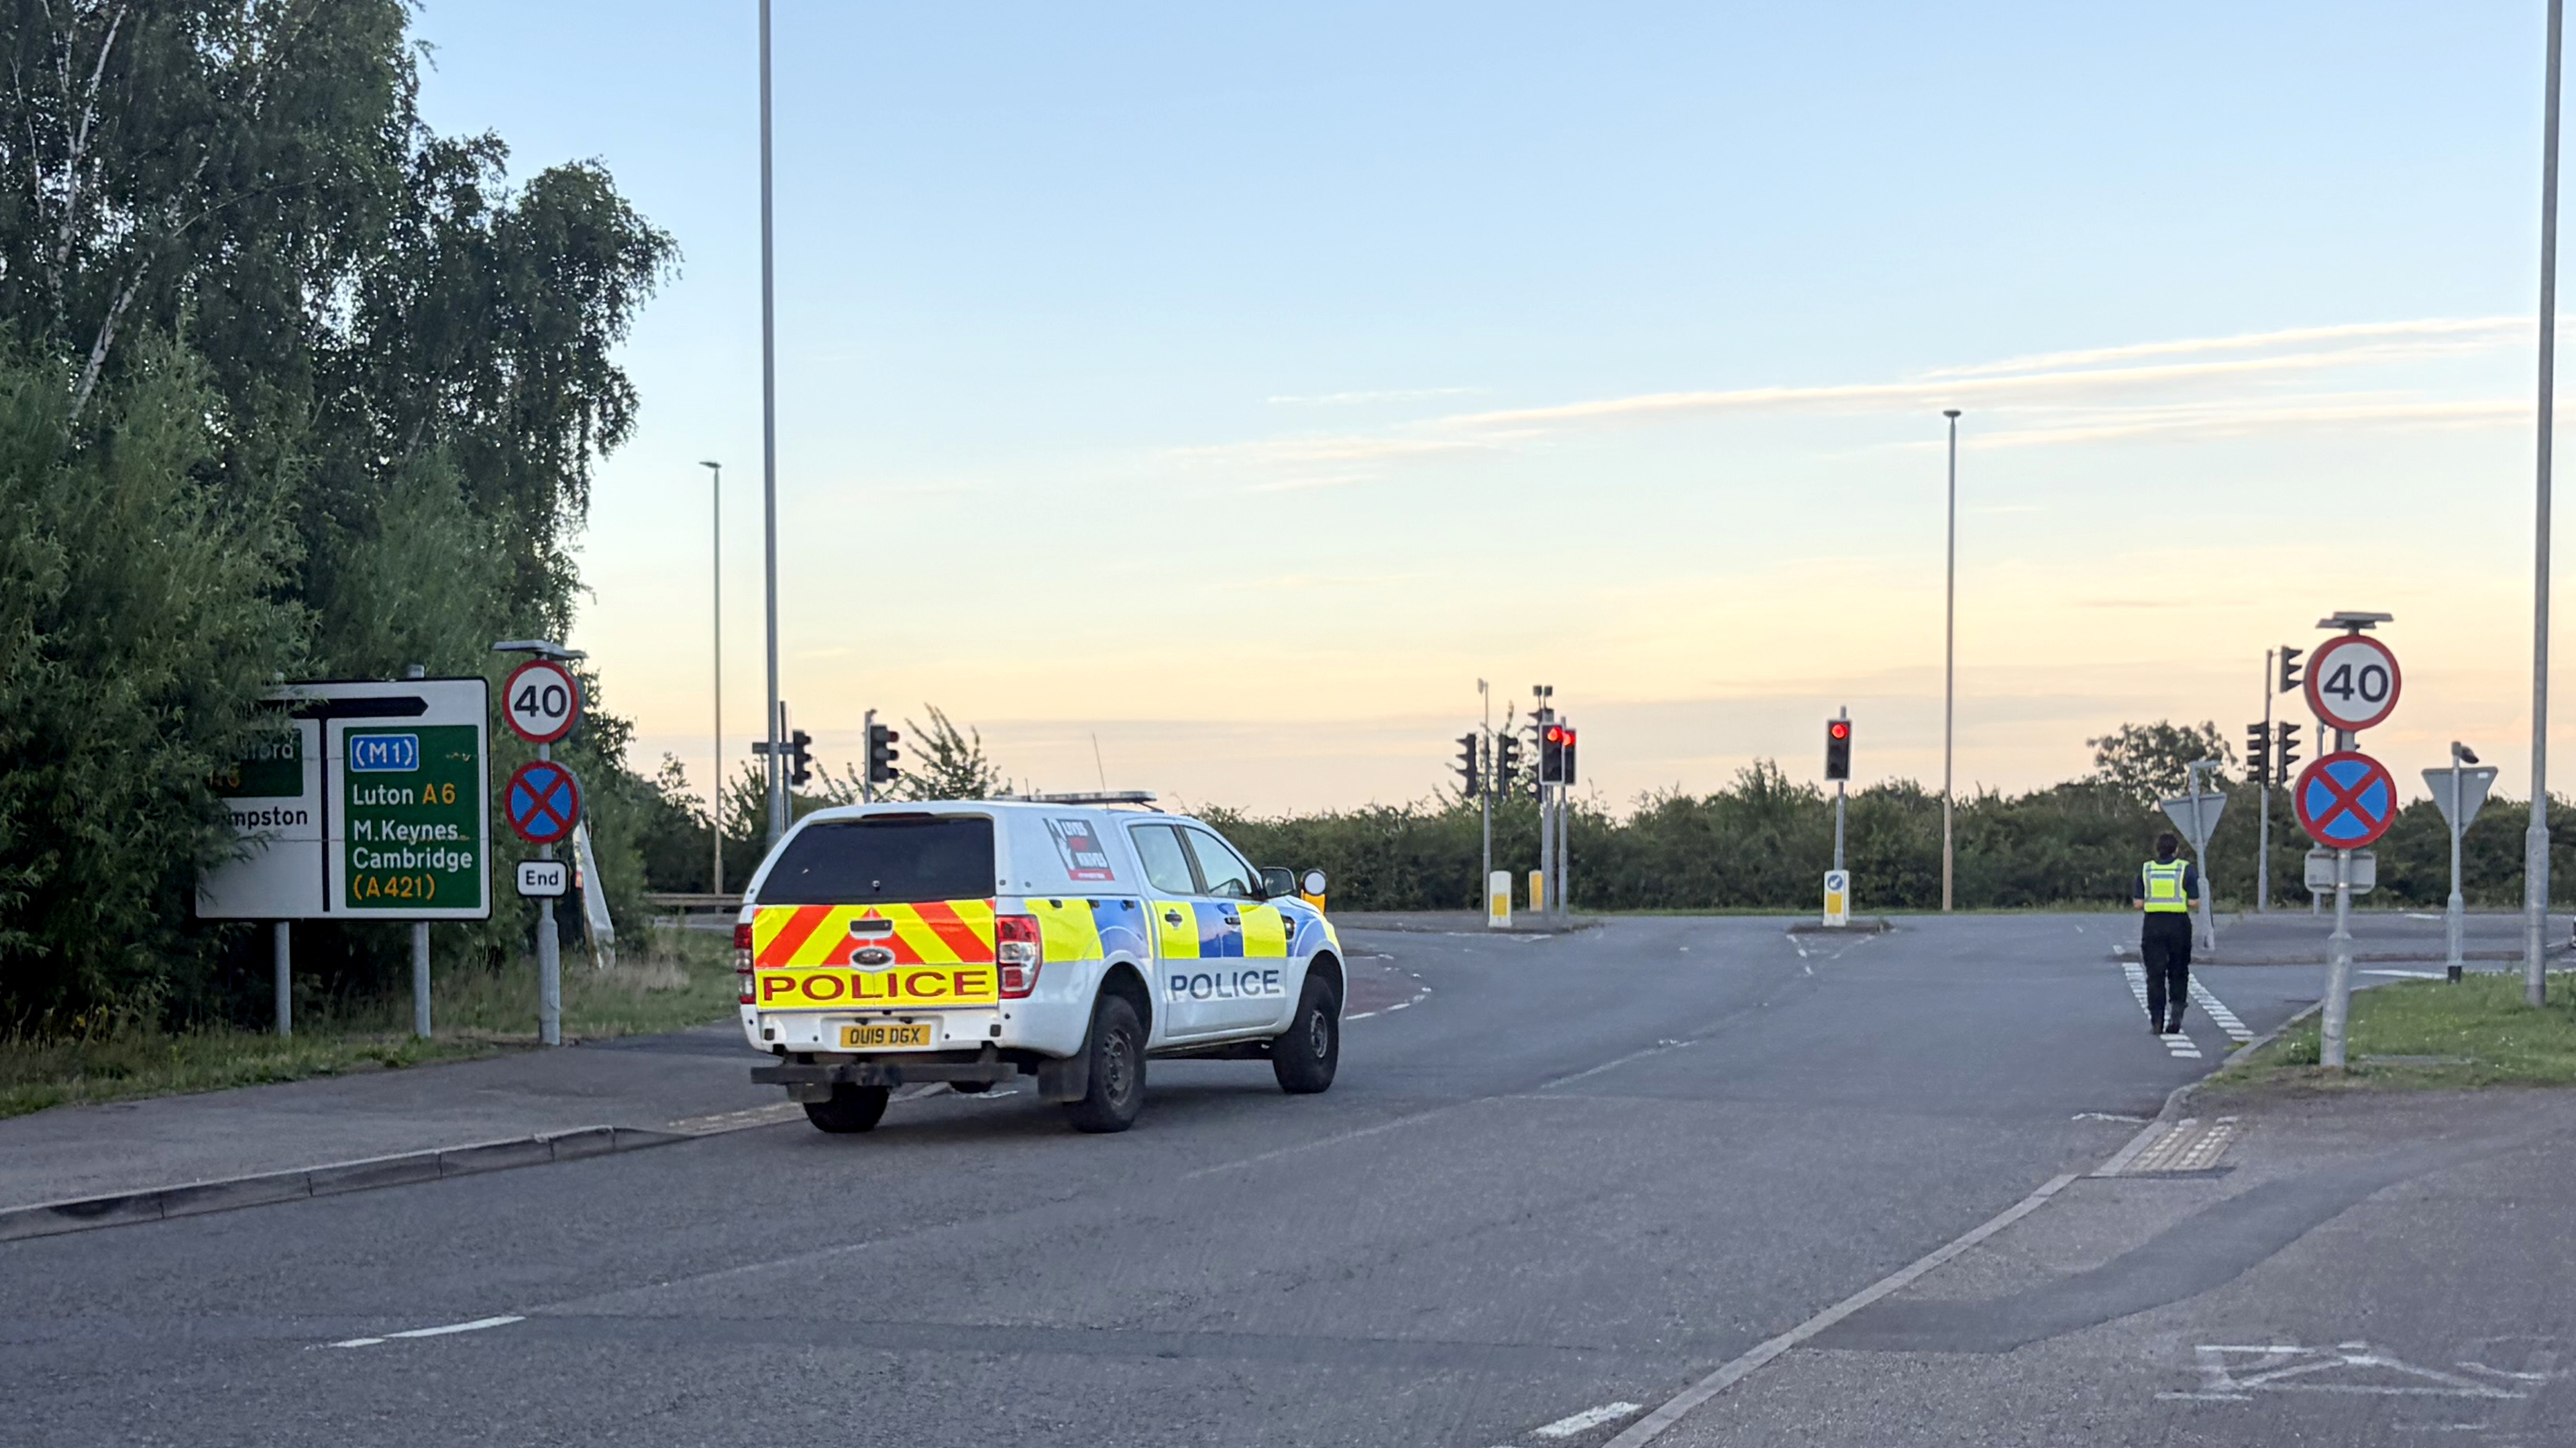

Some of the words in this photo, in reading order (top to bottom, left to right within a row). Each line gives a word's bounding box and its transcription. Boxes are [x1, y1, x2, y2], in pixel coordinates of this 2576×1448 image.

[2323, 663, 2389, 704] 40
[514, 685, 567, 718] 40
[356, 739, 413, 767] (M1)
[353, 783, 414, 805] Luton
[422, 783, 456, 805] A6
[232, 806, 308, 830] mpston
[354, 819, 459, 846] M.Keynes
[353, 846, 473, 873] Cambridge
[354, 873, 435, 901] (A421)
[525, 870, 559, 886] End
[763, 970, 991, 1001] POLICE
[1171, 970, 1281, 1001] POLICE
[850, 1028, 885, 1044] OU19
[890, 1027, 921, 1044] DGX
